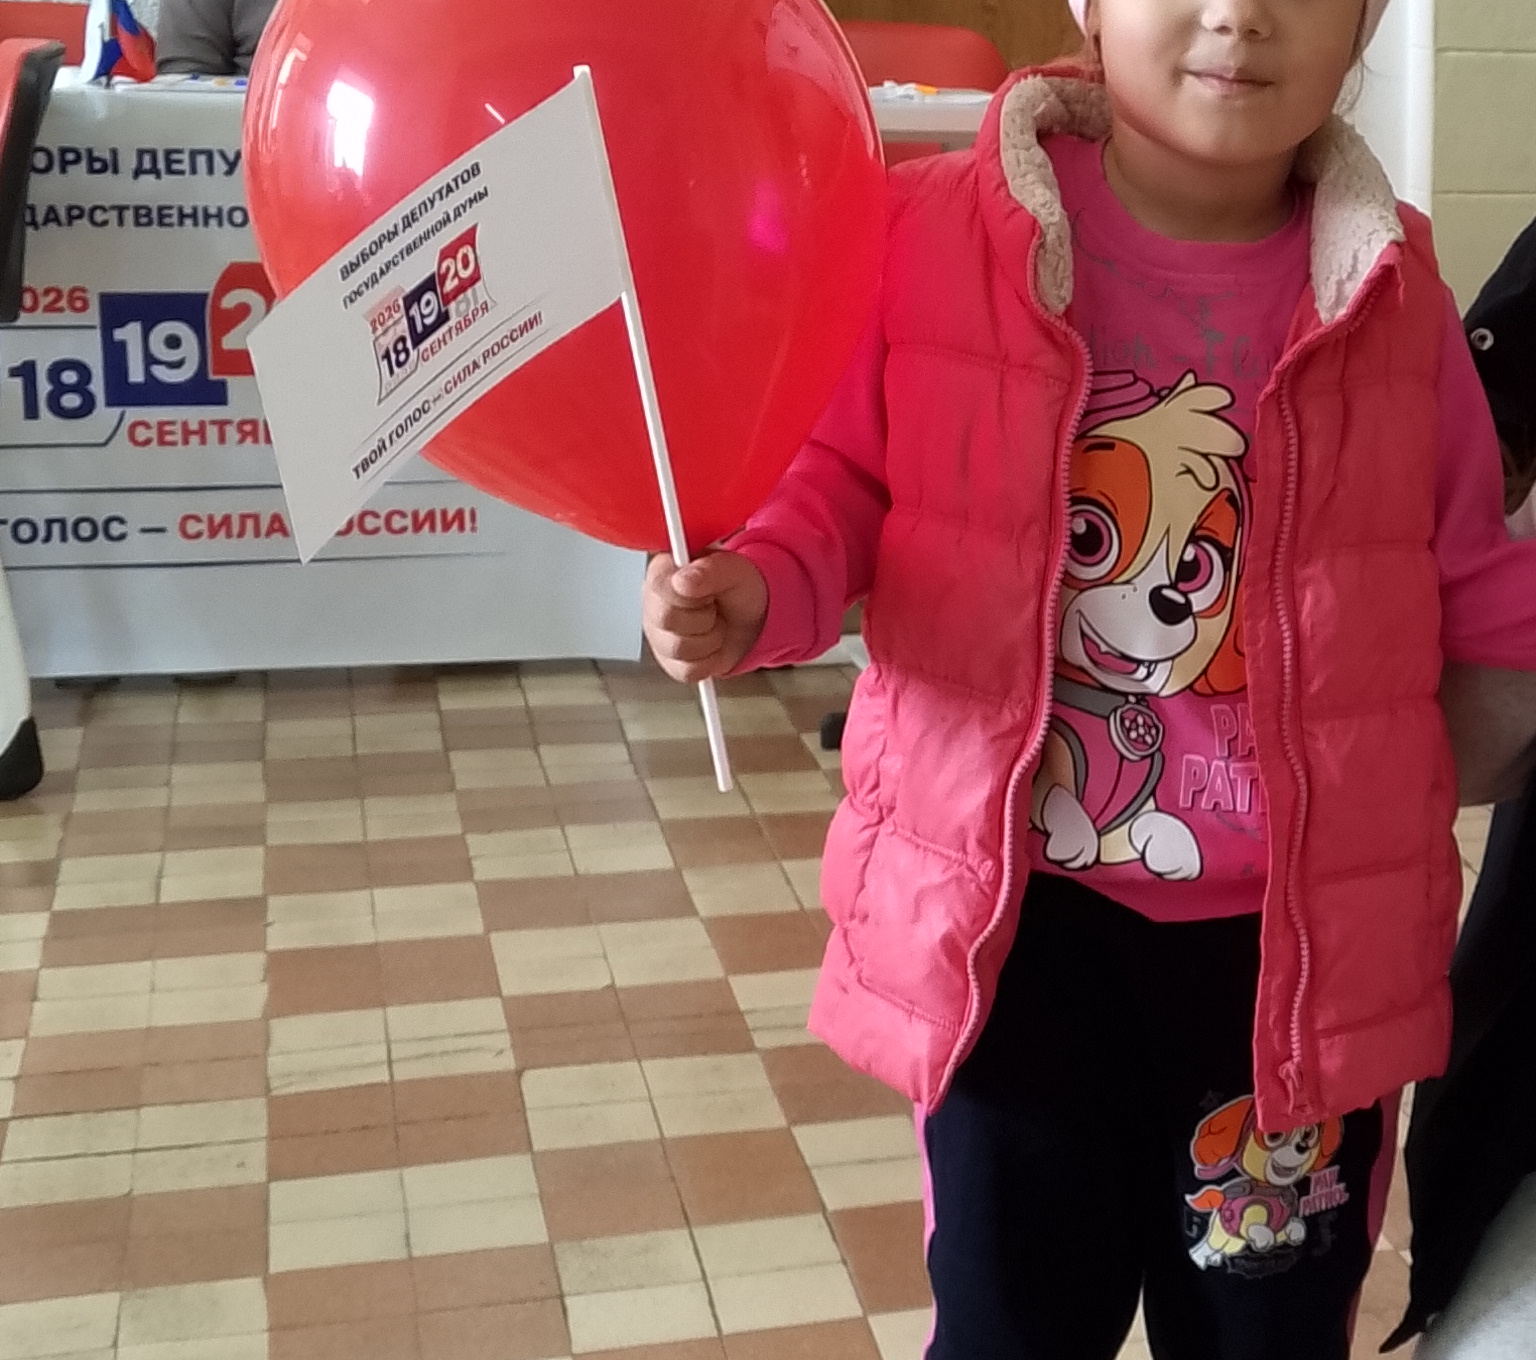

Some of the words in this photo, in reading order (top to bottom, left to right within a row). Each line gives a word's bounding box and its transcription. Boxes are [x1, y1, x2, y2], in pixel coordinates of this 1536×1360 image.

[30, 145, 119, 175] ОРЫ
[132, 146, 243, 180] ДЕПУ
[24, 203, 249, 231] ДАРСТВЕННО
[339, 222, 399, 281] ВЫБОРЫ
[400, 161, 482, 234] ДЕПУТАТОВ
[342, 210, 453, 310] ГОСУДАРСТВЕННОЙ
[453, 185, 489, 222] ДУМЫ
[439, 247, 476, 295] 20
[20, 285, 91, 314] 026
[221, 288, 267, 350] 2
[369, 299, 402, 334] 2026
[408, 295, 439, 334] 19
[112, 320, 200, 384] 19
[381, 335, 411, 377] 18
[420, 300, 490, 363] СЕНТЯБРЯ
[8, 358, 97, 421] 18
[351, 439, 387, 480] ТВОЙ
[388, 401, 431, 447] ГОЛОС
[443, 360, 481, 397] СИЛА
[481, 311, 545, 367] РОССИИ!
[177, 510, 291, 541] СИЛА
[335, 506, 478, 538] ССИИ!
[1179, 753, 1267, 814] PAT
